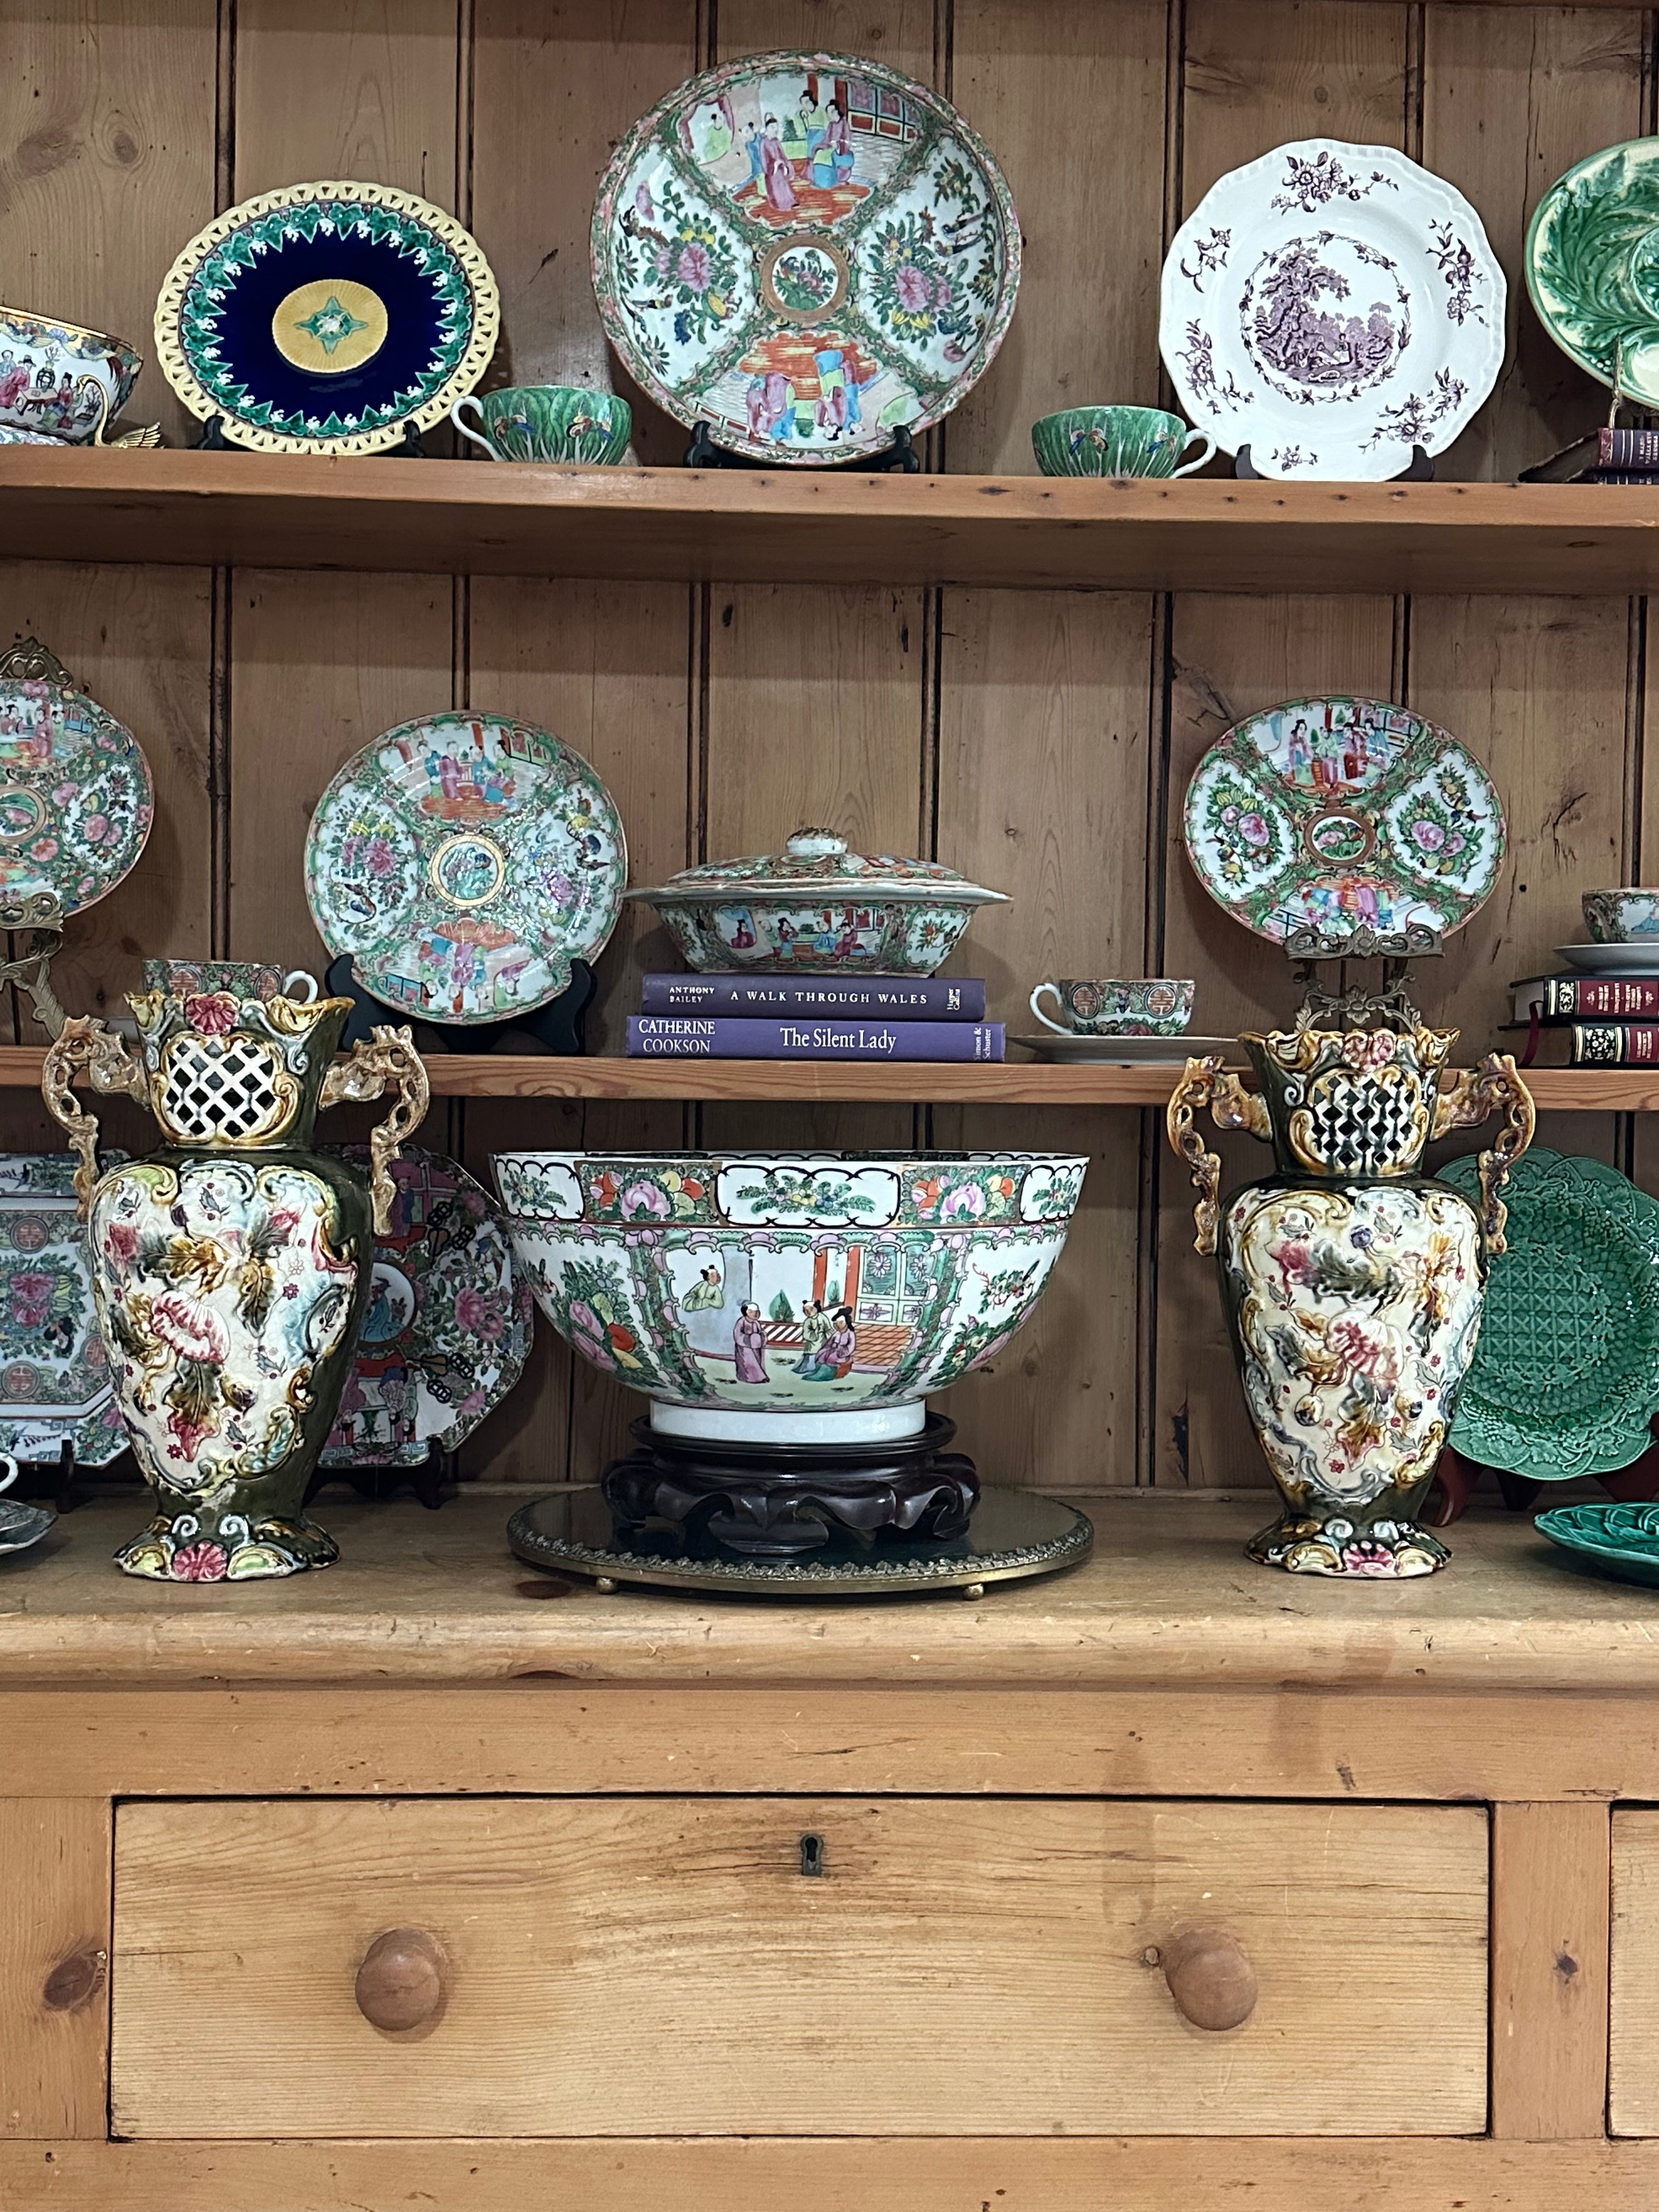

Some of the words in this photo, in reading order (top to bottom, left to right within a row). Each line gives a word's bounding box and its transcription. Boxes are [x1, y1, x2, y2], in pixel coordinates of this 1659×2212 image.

[669, 995, 703, 1003] BAILEY
[730, 991, 739, 1001] A
[747, 991, 787, 1001] WALK
[795, 991, 870, 1003] THROUGH
[878, 993, 927, 1005] WALES
[946, 988, 955, 1010] Harper
[638, 1019, 715, 1035] CATHERINE
[974, 1027, 981, 1035] &
[643, 1038, 711, 1053] COOKSON
[780, 1027, 810, 1047] The
[813, 1028, 855, 1048] Silent
[859, 1029, 896, 1054] Lady
[983, 1028, 991, 1059] Schuster
